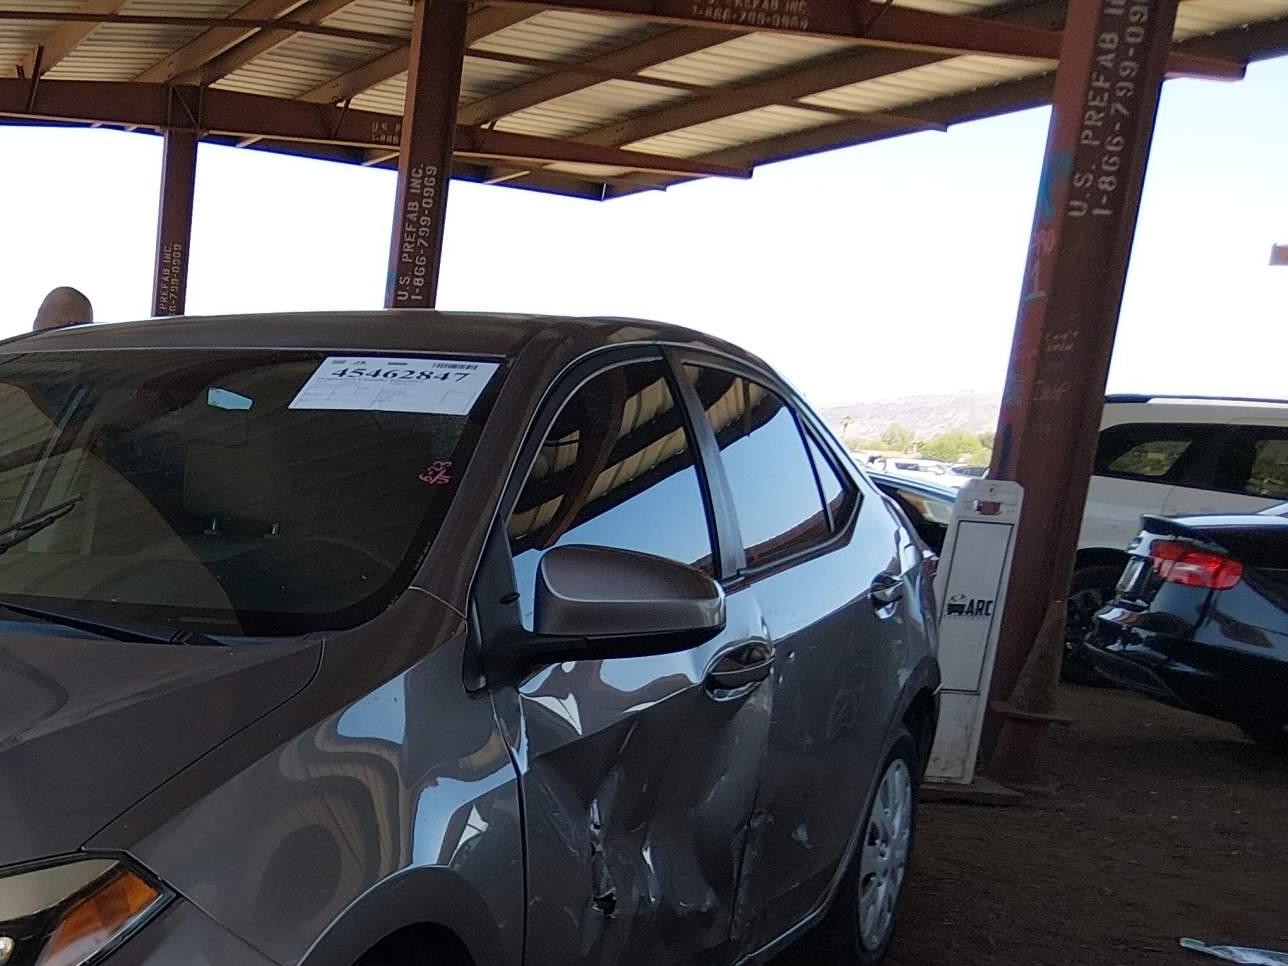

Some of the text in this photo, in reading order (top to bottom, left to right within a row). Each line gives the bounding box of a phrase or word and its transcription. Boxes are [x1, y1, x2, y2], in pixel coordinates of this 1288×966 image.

[1080, 32, 1119, 145] PREFAB
[1091, 0, 1150, 214] 1-866-799-09
[1067, 164, 1096, 216] U.S.
[402, 201, 419, 262] PREFAB
[411, 165, 438, 300] 1-866-799-0969
[397, 271, 412, 300] U.S.
[331, 367, 471, 383] 45462847
